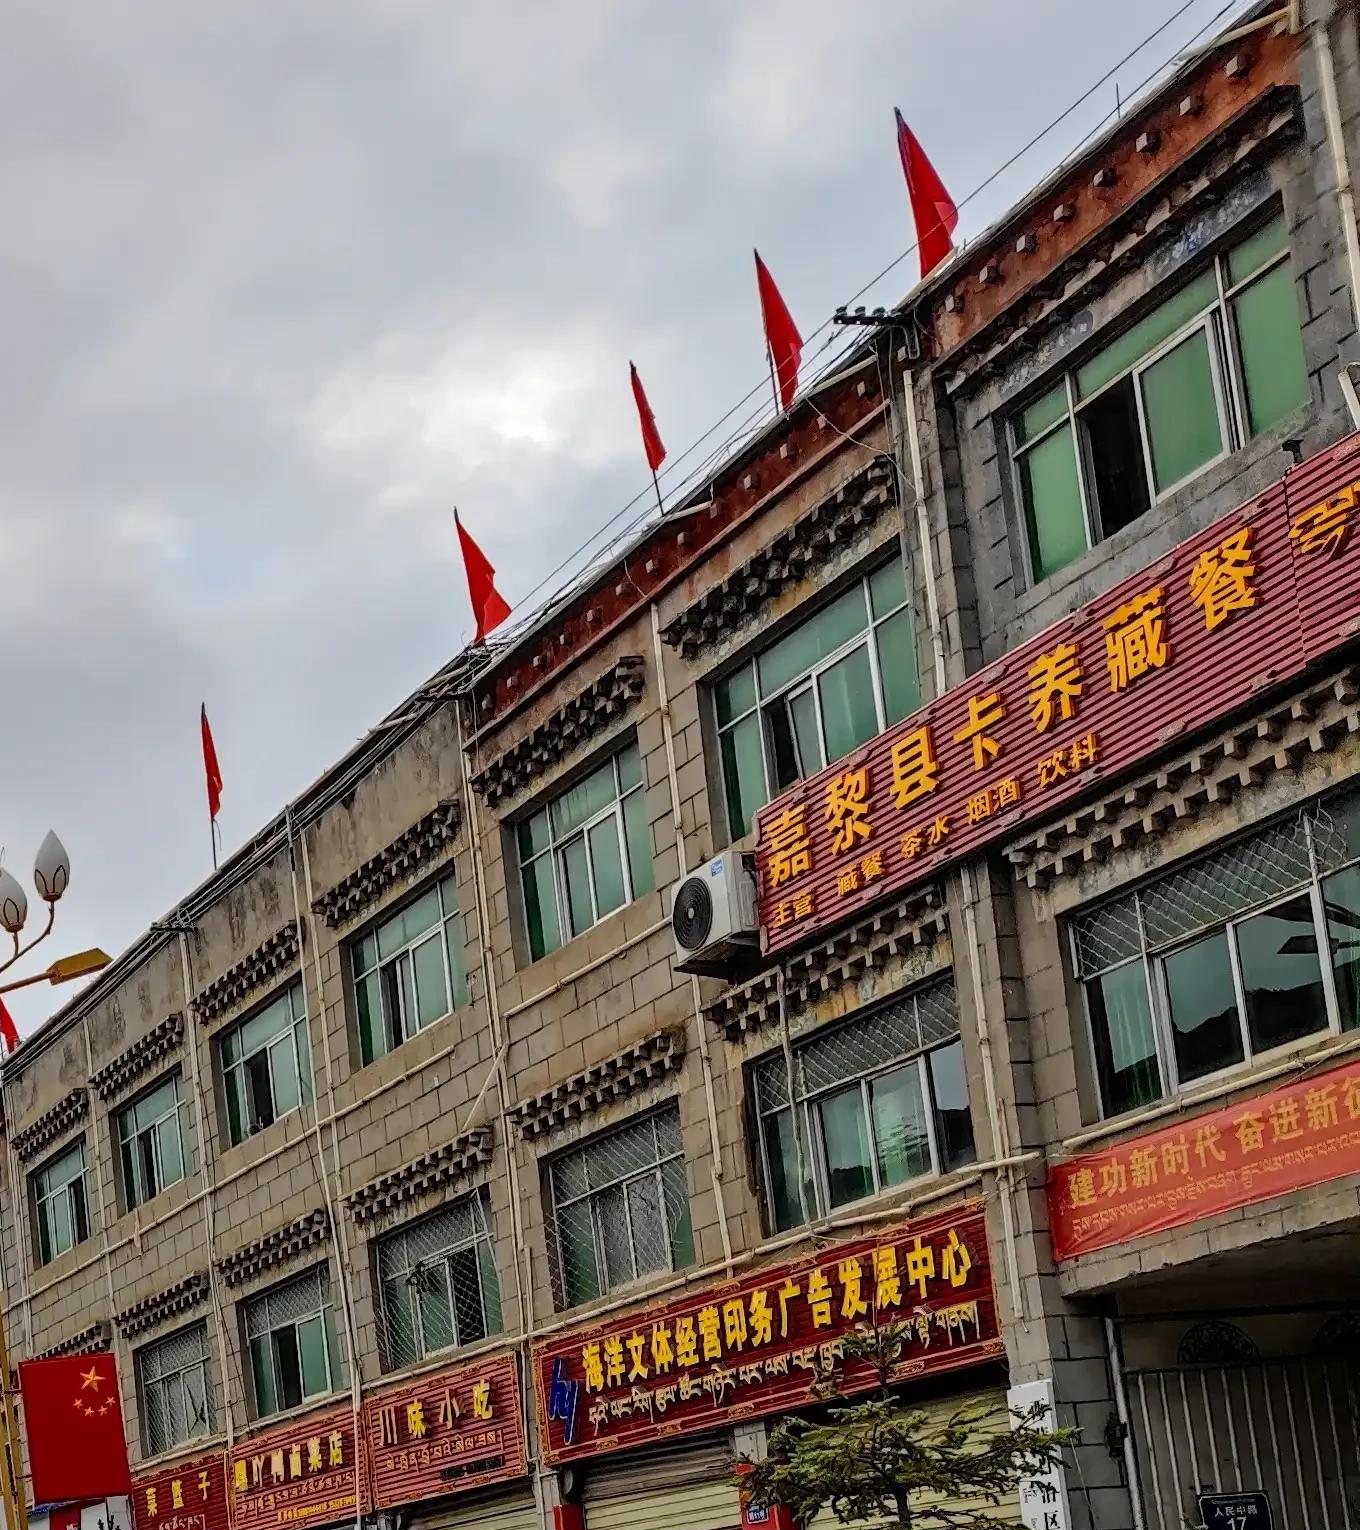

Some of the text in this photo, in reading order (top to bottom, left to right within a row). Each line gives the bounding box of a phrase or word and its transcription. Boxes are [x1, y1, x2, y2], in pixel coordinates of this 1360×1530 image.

[900, 815, 952, 858] 茶水
[965, 778, 1022, 825] 烟酒
[1036, 733, 1099, 790] 饮料
[1068, 1122, 1228, 1209] 建功新时代
[581, 1227, 973, 1394] 海洋文体经营印务广告发展中心
[378, 1378, 494, 1447] 川味小吃
[1214, 1504, 1258, 1518] 人民中路
